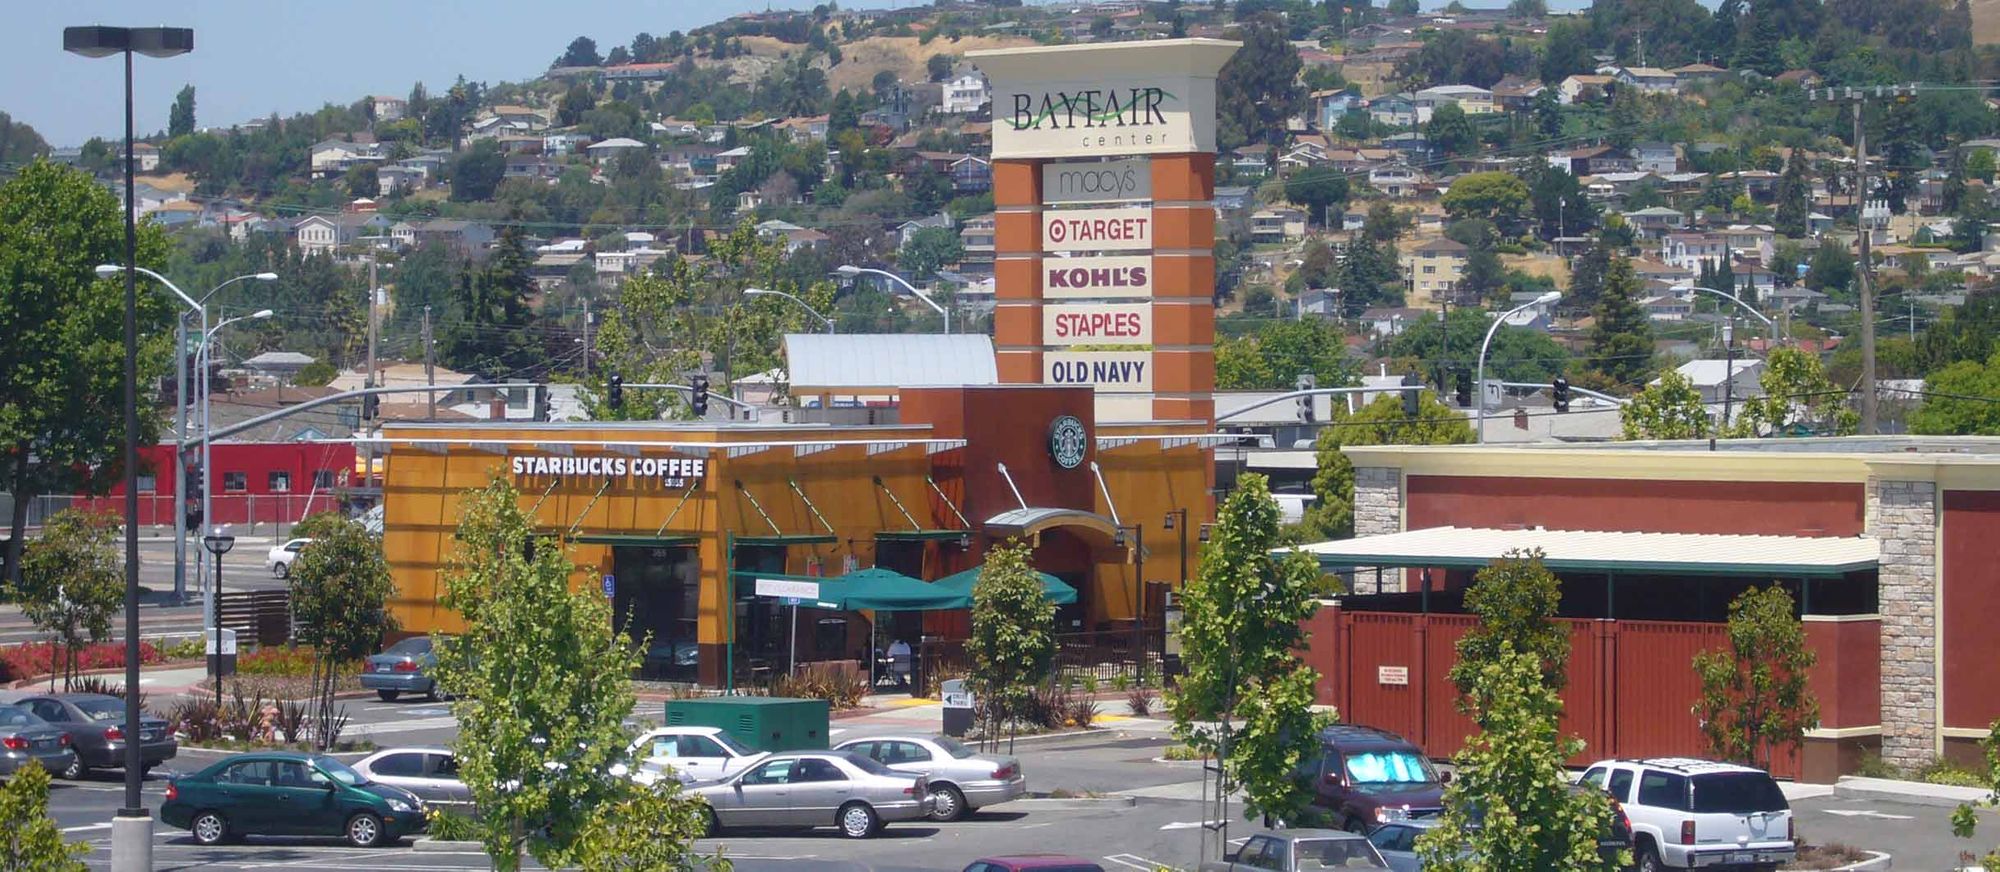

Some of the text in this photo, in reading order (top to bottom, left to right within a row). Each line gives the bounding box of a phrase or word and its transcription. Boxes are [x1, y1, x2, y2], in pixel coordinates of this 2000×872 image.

[1012, 87, 1168, 131] BAYFAIR
[1082, 132, 1168, 147] center
[1059, 165, 1136, 198] macy's
[1069, 218, 1147, 241] TARGET
[1049, 266, 1147, 288] KOHL'S
[1055, 312, 1141, 337] STAPLES
[1052, 361, 1145, 383] OLD NAVY
[512, 457, 704, 477] STARBUCKS COFFEE
